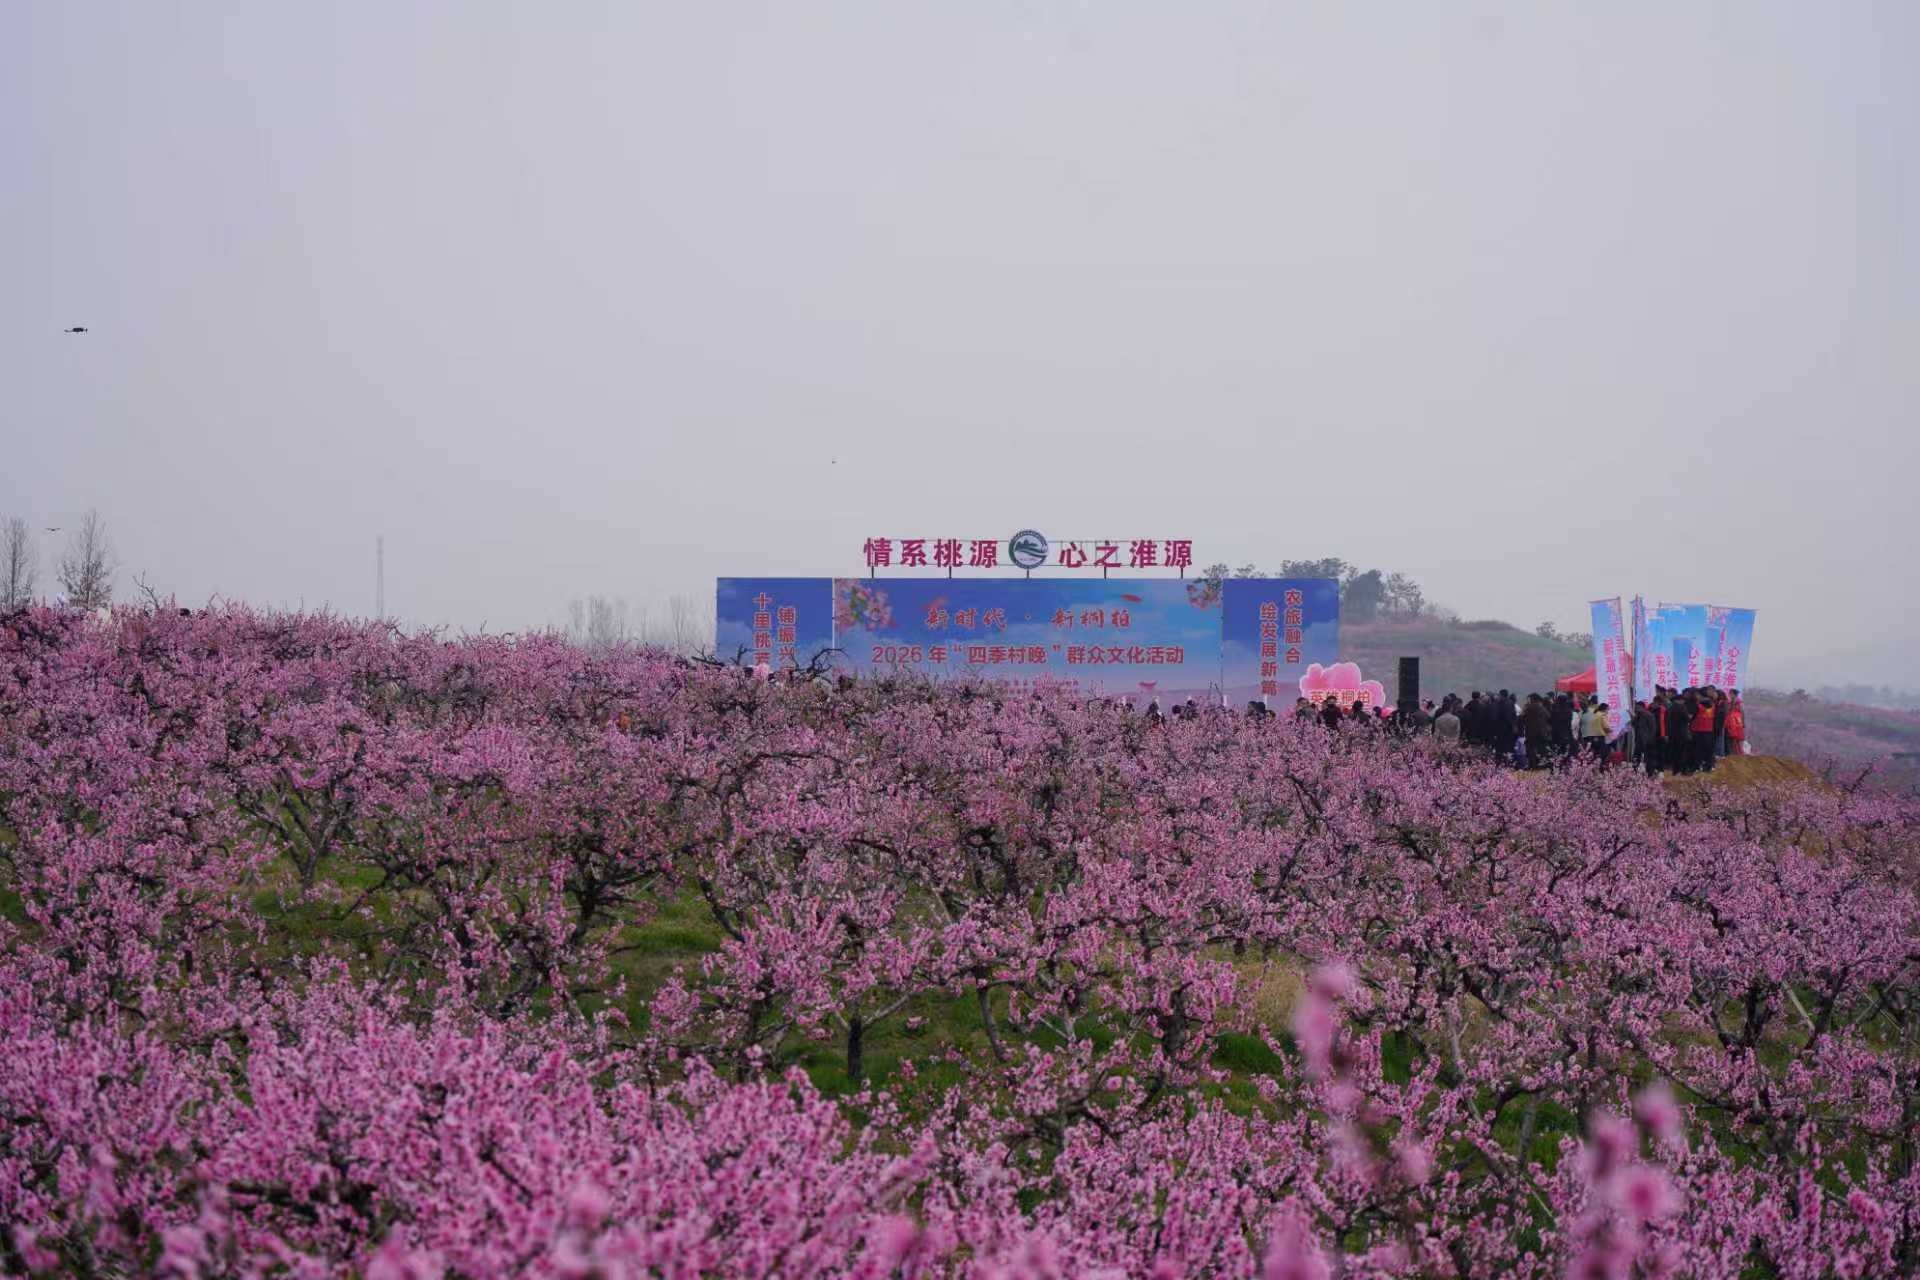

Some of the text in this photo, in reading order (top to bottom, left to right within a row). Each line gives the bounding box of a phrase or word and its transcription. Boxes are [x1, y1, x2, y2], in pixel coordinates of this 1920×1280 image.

[864, 537, 998, 568] 情系桃源
[1059, 540, 1193, 568] 心之淮源
[1260, 601, 1278, 696] 绘发展新篇
[1285, 588, 1303, 664] 农旅融合
